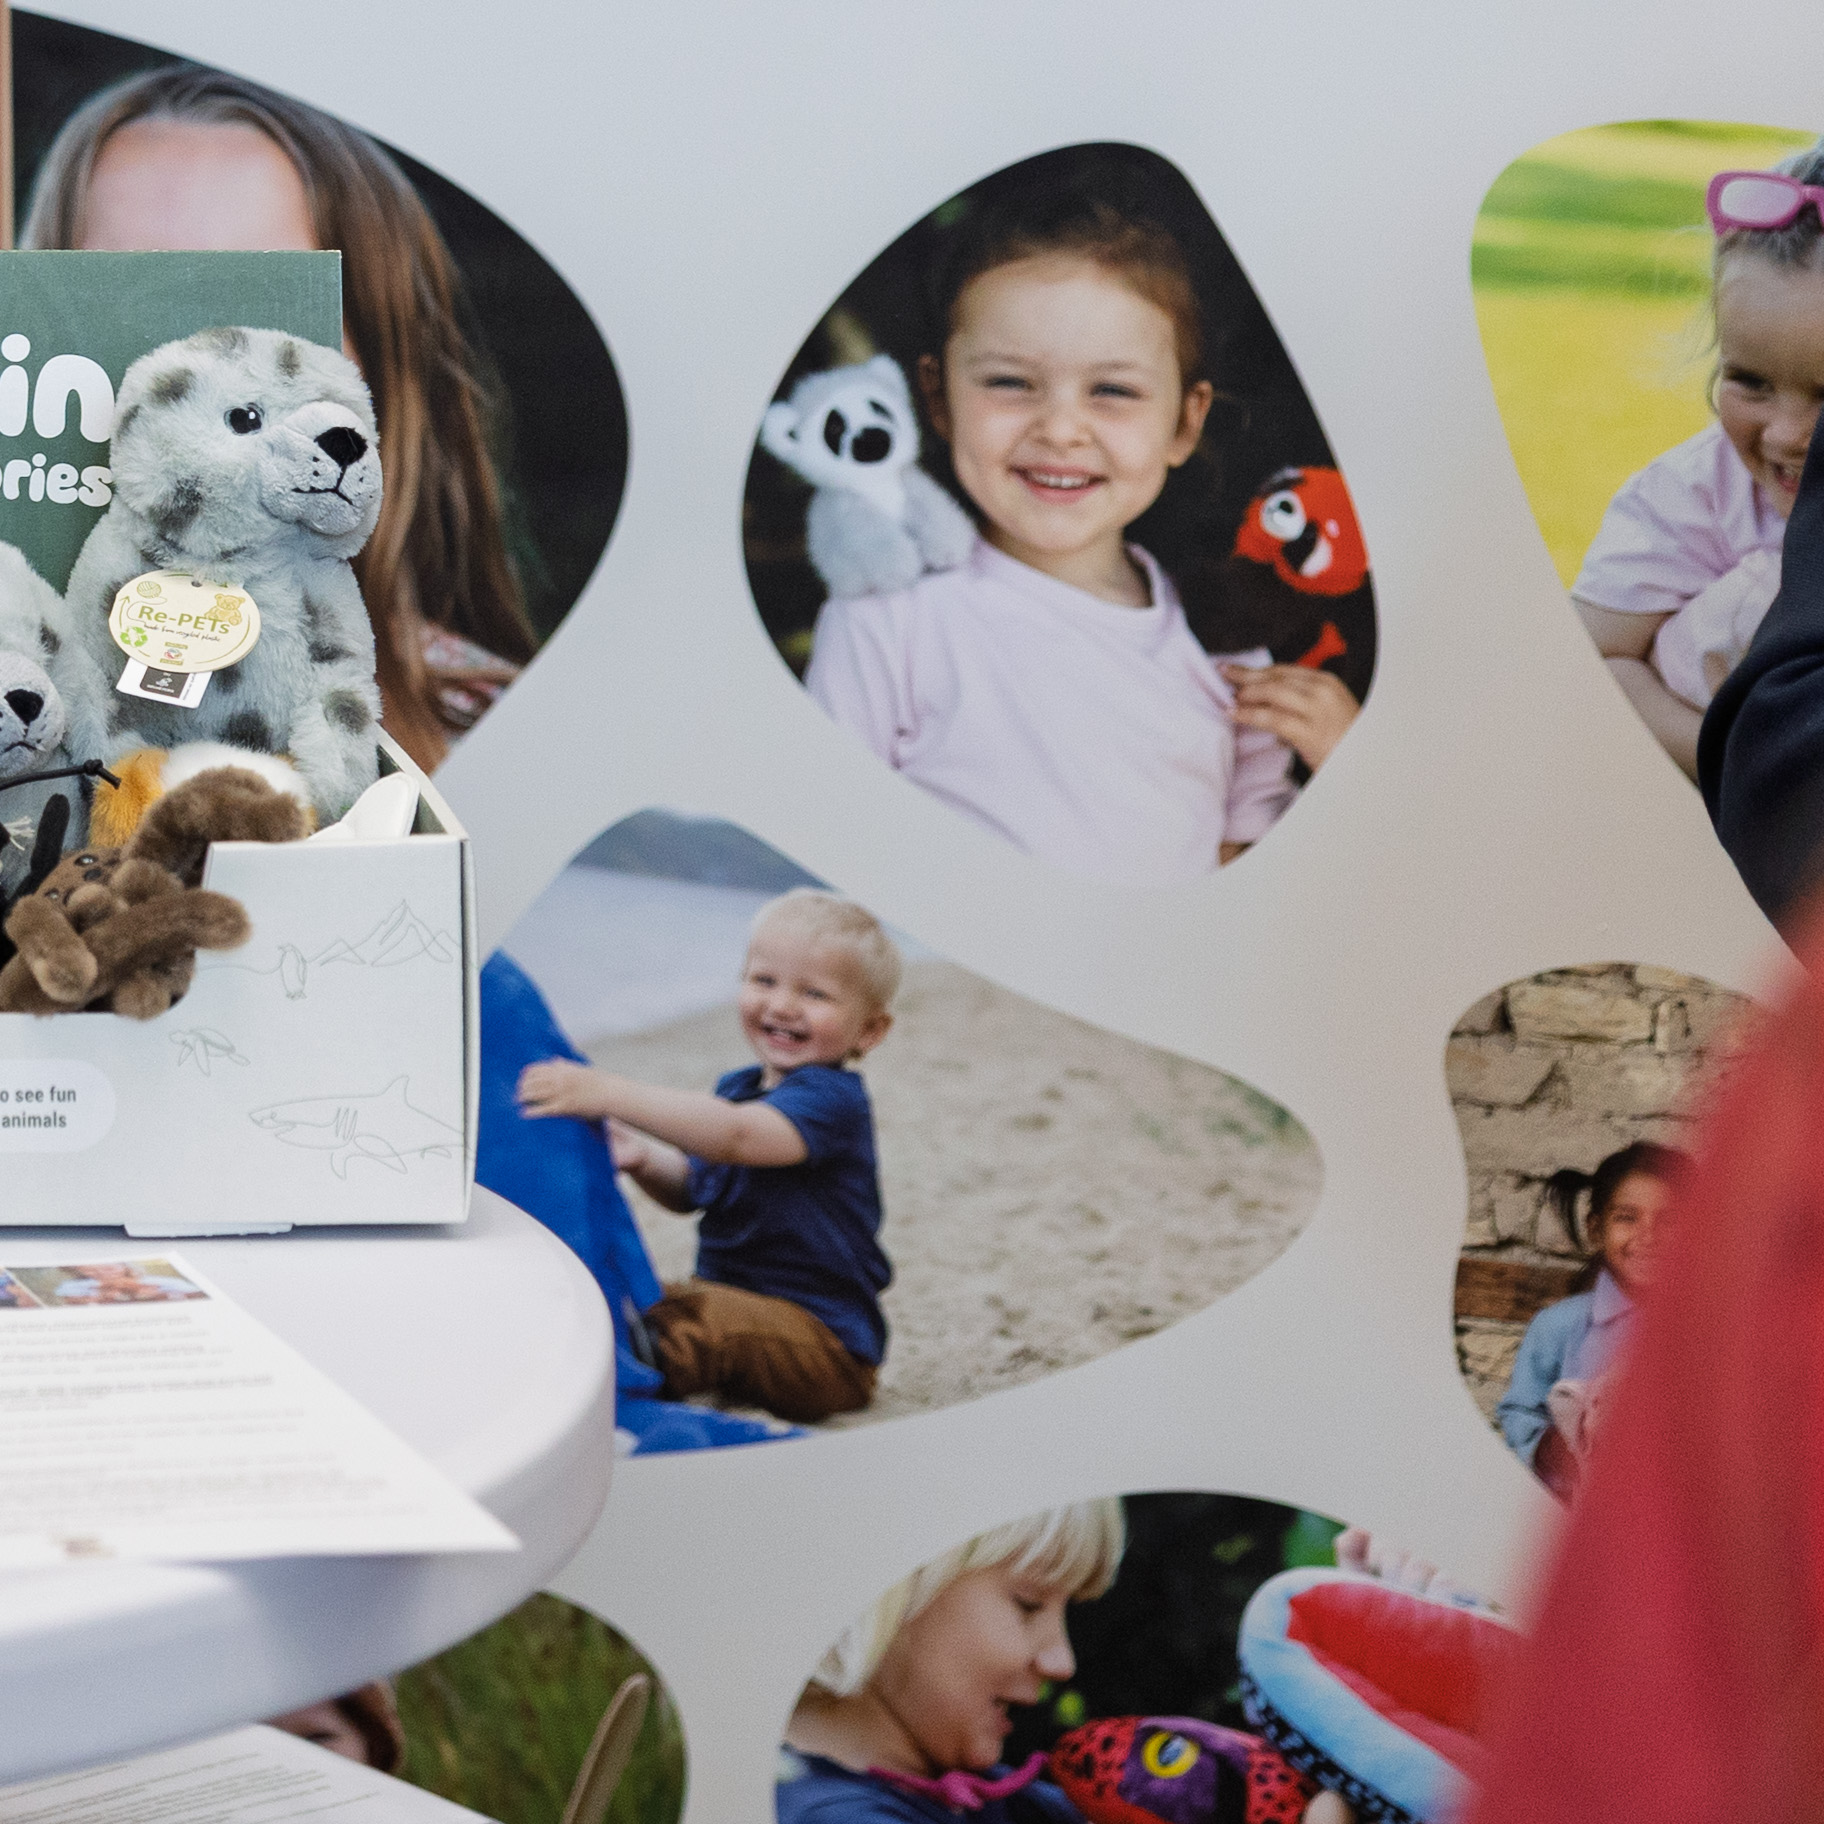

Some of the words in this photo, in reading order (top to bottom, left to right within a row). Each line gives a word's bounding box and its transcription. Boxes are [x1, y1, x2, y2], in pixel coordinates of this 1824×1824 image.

[138, 606, 230, 634] Re-PETs
[15, 1089, 45, 1103] see
[50, 1086, 77, 1103] fun
[1, 1111, 67, 1129] animals
